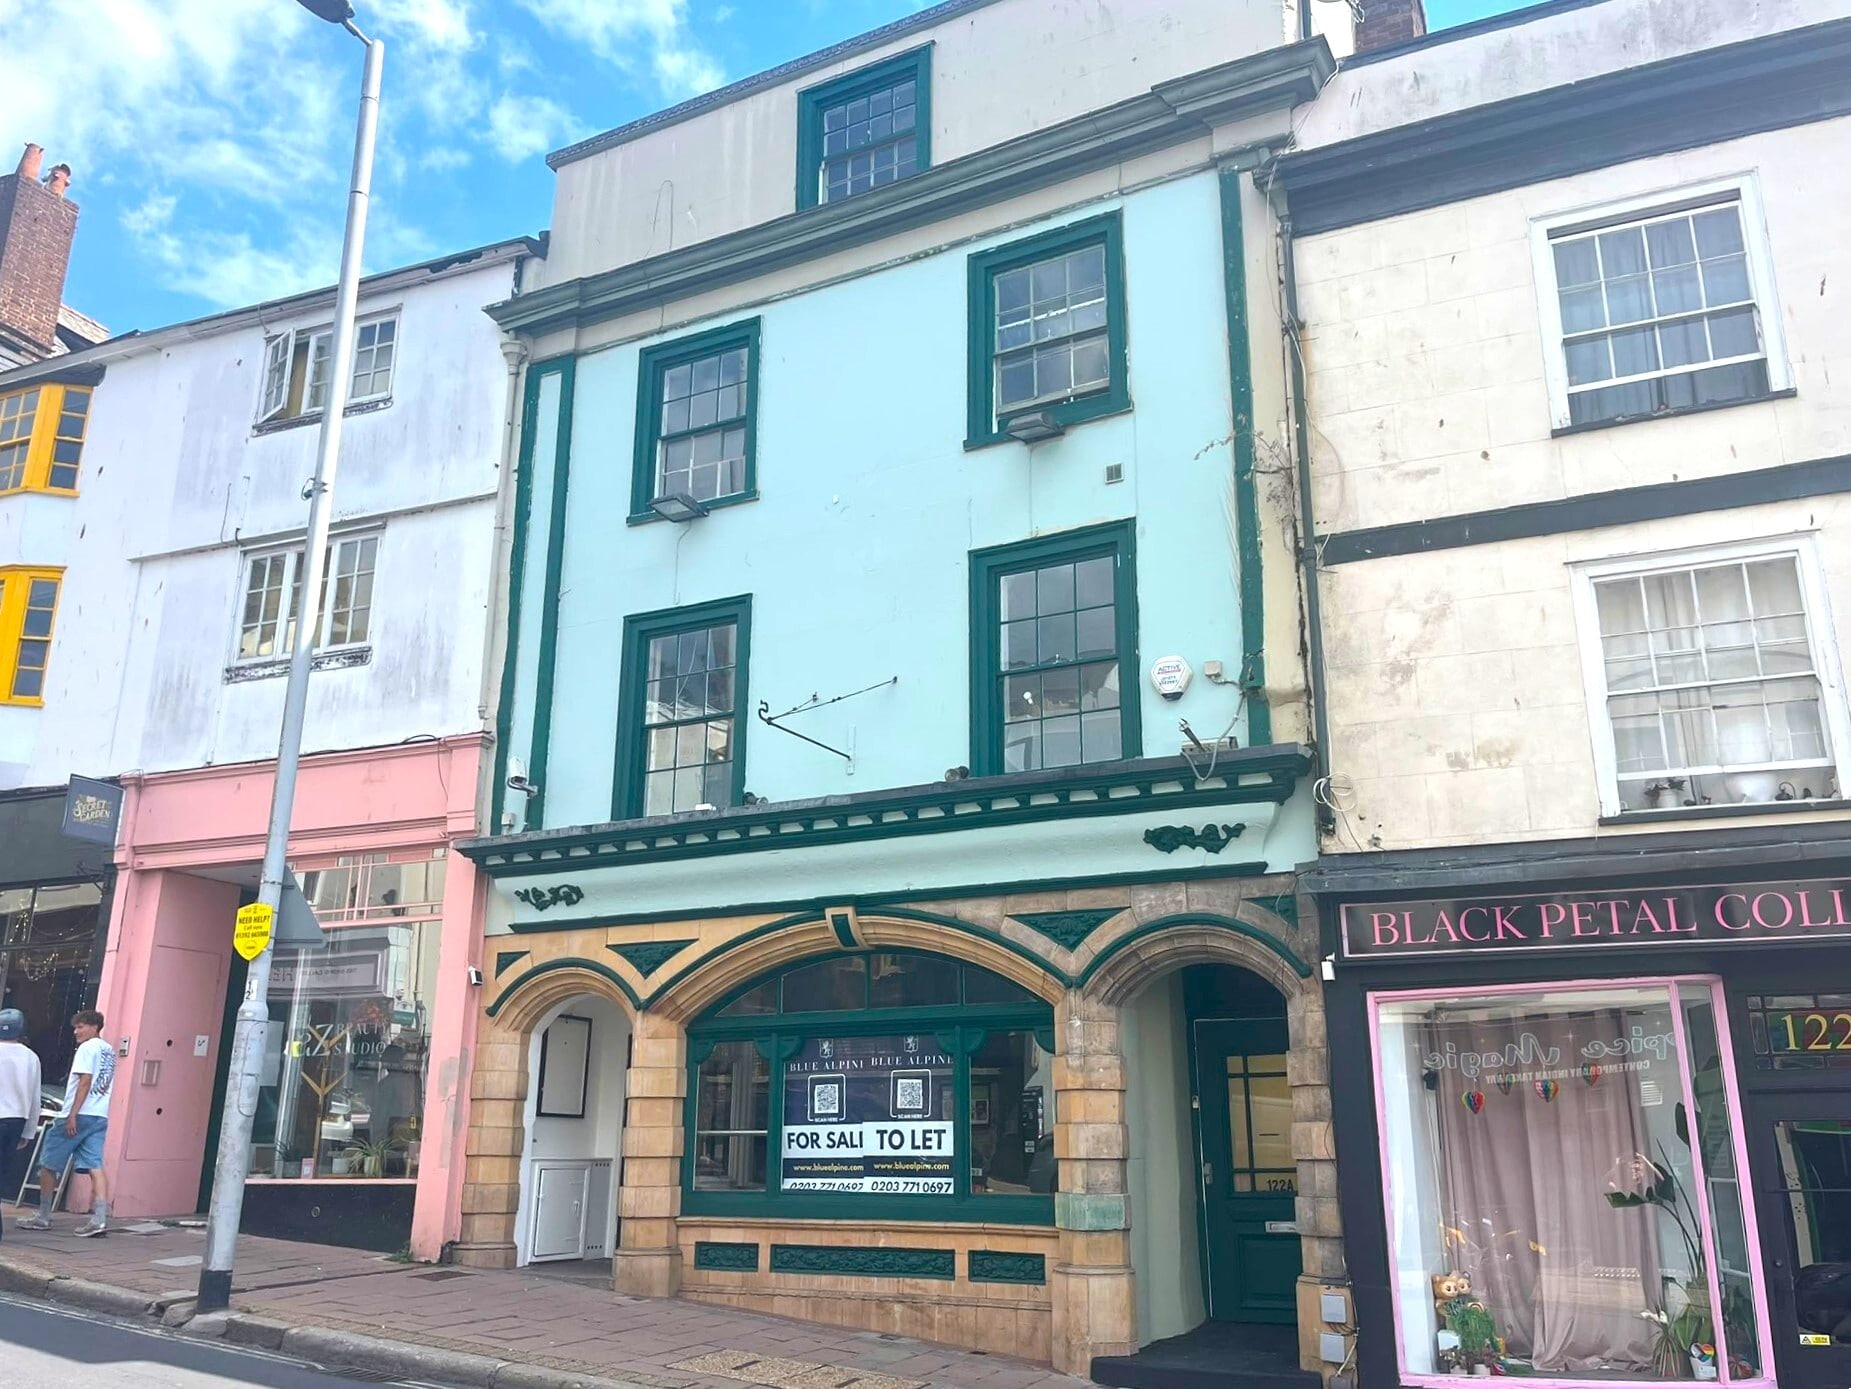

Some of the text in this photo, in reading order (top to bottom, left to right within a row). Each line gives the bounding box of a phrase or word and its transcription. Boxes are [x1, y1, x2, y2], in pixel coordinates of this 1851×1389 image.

[239, 915, 270, 924] NEED HELP?
[1371, 904, 1528, 947] BLACK
[1536, 896, 1698, 938] PETAL
[1780, 1014, 1851, 1052] 122
[871, 1056, 903, 1066] BLUE
[790, 1062, 818, 1073] BLUE
[787, 1131, 822, 1150] FOR
[876, 1129, 947, 1150] TO LET
[793, 1163, 864, 1173] www.bluealpine.com
[873, 1161, 950, 1173] www.bluealpine.com
[870, 1181, 953, 1193] 0203 771 0697
[1266, 1179, 1295, 1193] 122A
